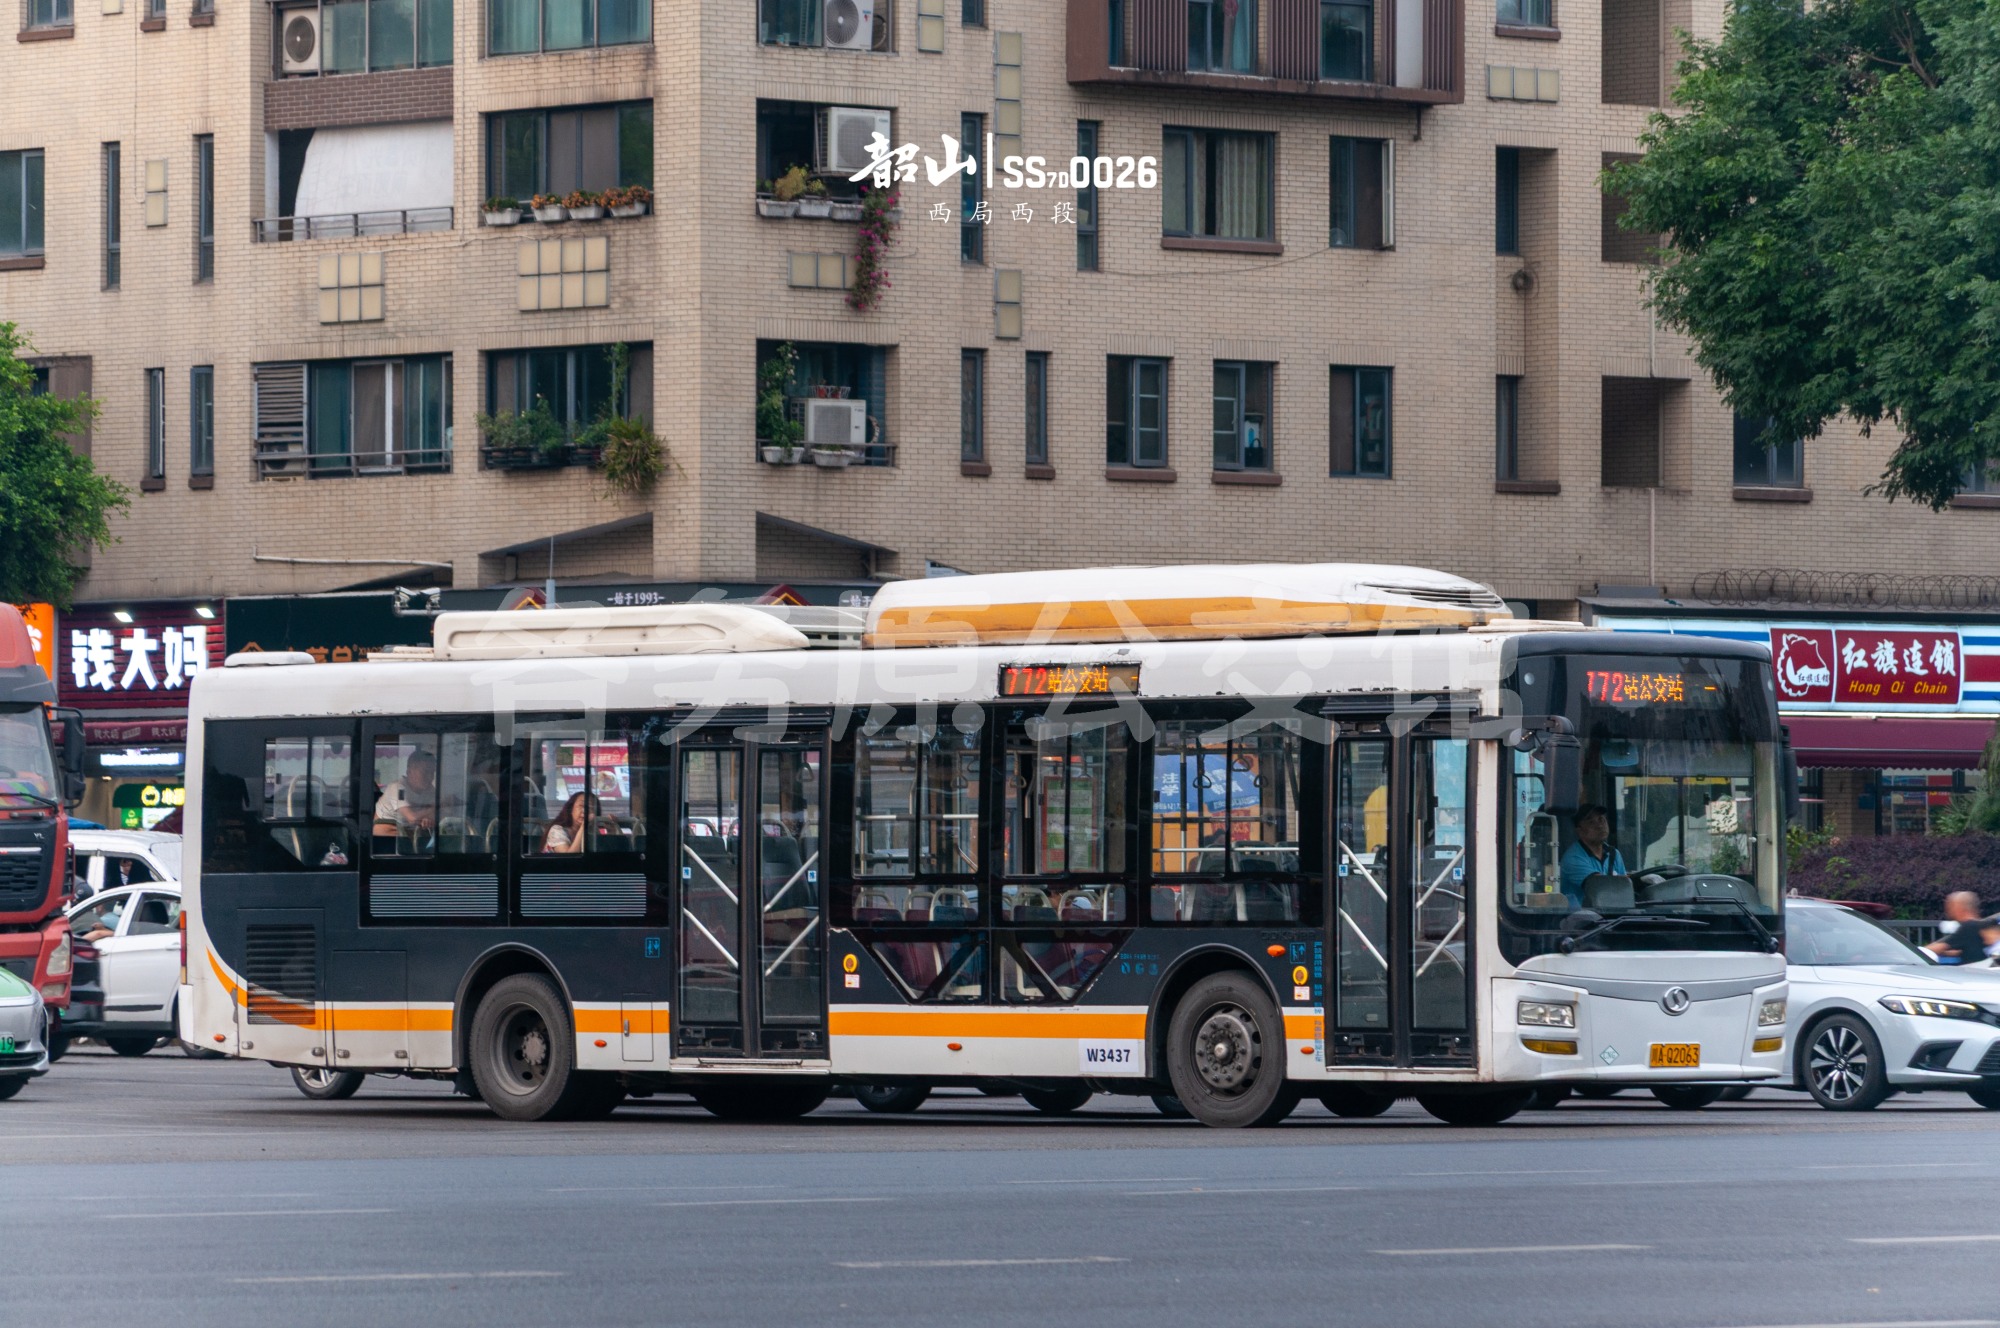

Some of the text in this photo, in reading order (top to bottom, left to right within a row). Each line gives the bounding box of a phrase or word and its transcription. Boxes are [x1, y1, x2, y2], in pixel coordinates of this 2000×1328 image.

[71, 625, 208, 692] 钱大妈
[1841, 637, 1957, 677] 红旗连锁
[1849, 680, 1948, 696] Hong Qi Chain
[1086, 1048, 1131, 1064] W3437
